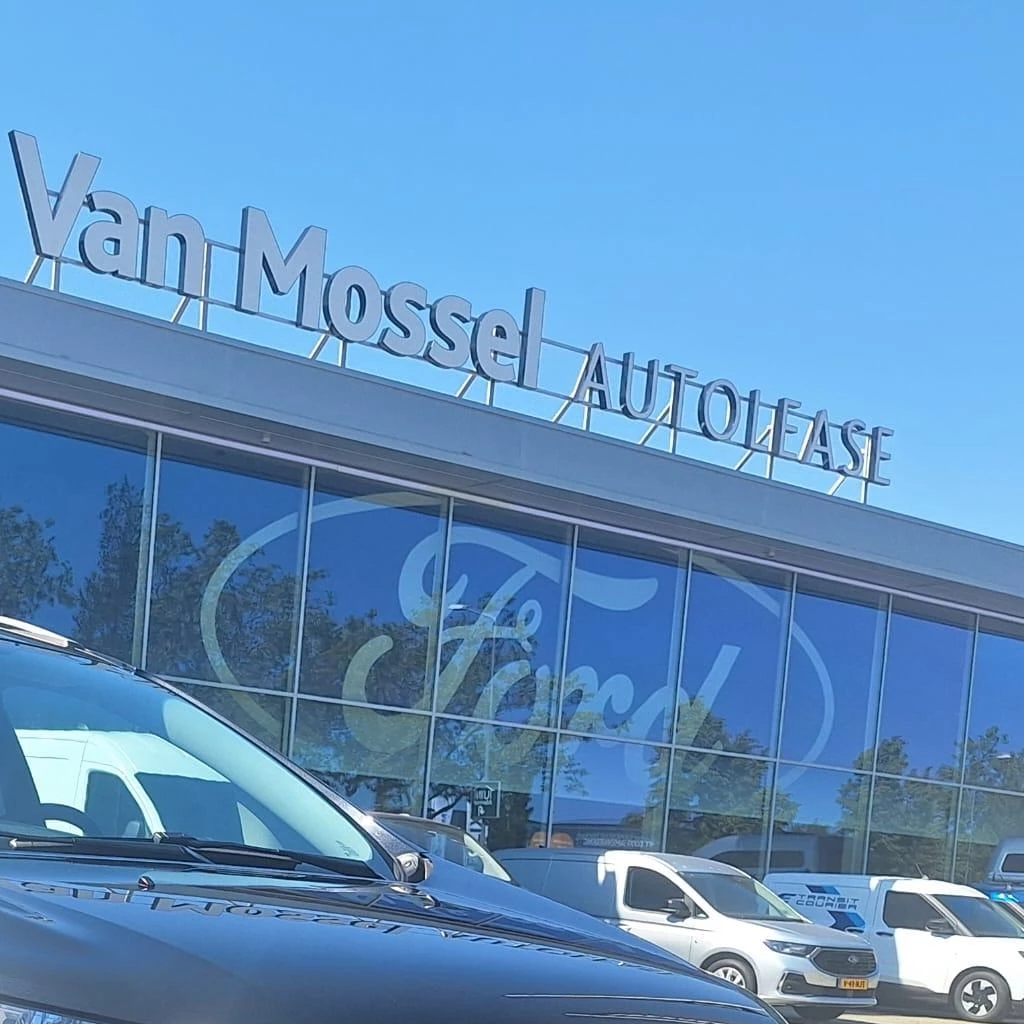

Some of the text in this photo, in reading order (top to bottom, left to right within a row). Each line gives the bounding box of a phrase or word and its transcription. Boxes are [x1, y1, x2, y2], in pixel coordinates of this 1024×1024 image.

[8, 129, 894, 487] Van Mossel AUTOLEASE
[340, 525, 743, 790] Ford
[796, 899, 858, 911] COURIER
[797, 893, 861, 904] TRANSIT
